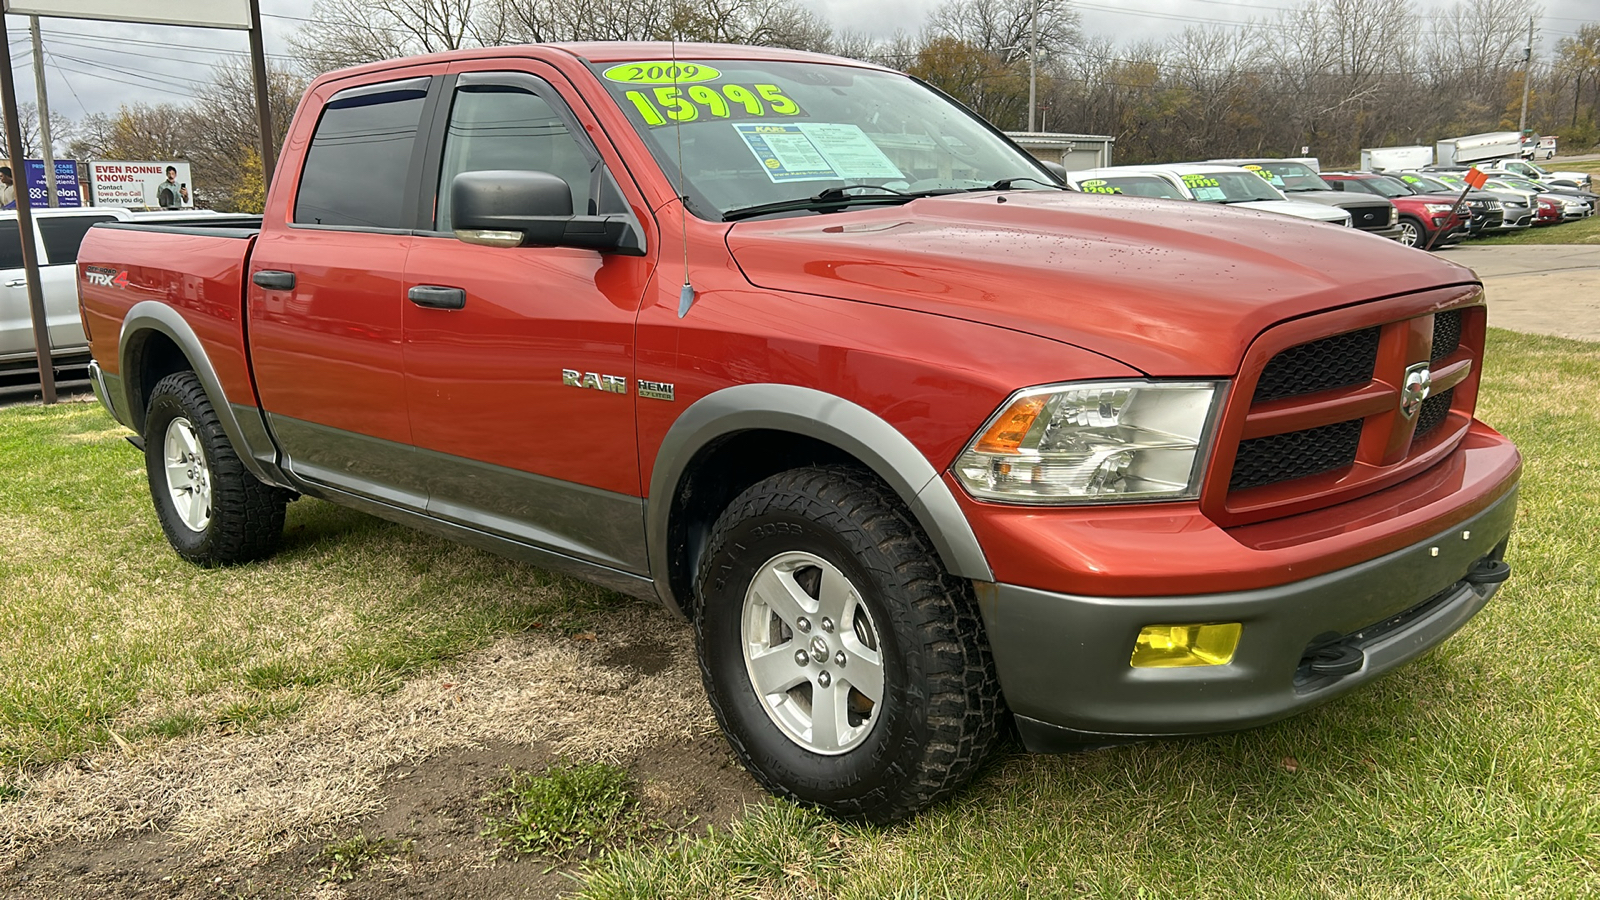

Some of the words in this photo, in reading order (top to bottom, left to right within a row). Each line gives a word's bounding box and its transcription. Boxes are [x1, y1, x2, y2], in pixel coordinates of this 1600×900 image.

[629, 65, 699, 81] 2009
[625, 83, 801, 126] 15995
[95, 165, 122, 174] EVEN
[125, 166, 162, 174] RONNIE
[1184, 178, 1219, 188] 17995
[41, 188, 77, 197] celon
[87, 265, 117, 274] OFF-ROAD
[562, 368, 627, 394] RAM
[638, 379, 674, 393] HEMI
